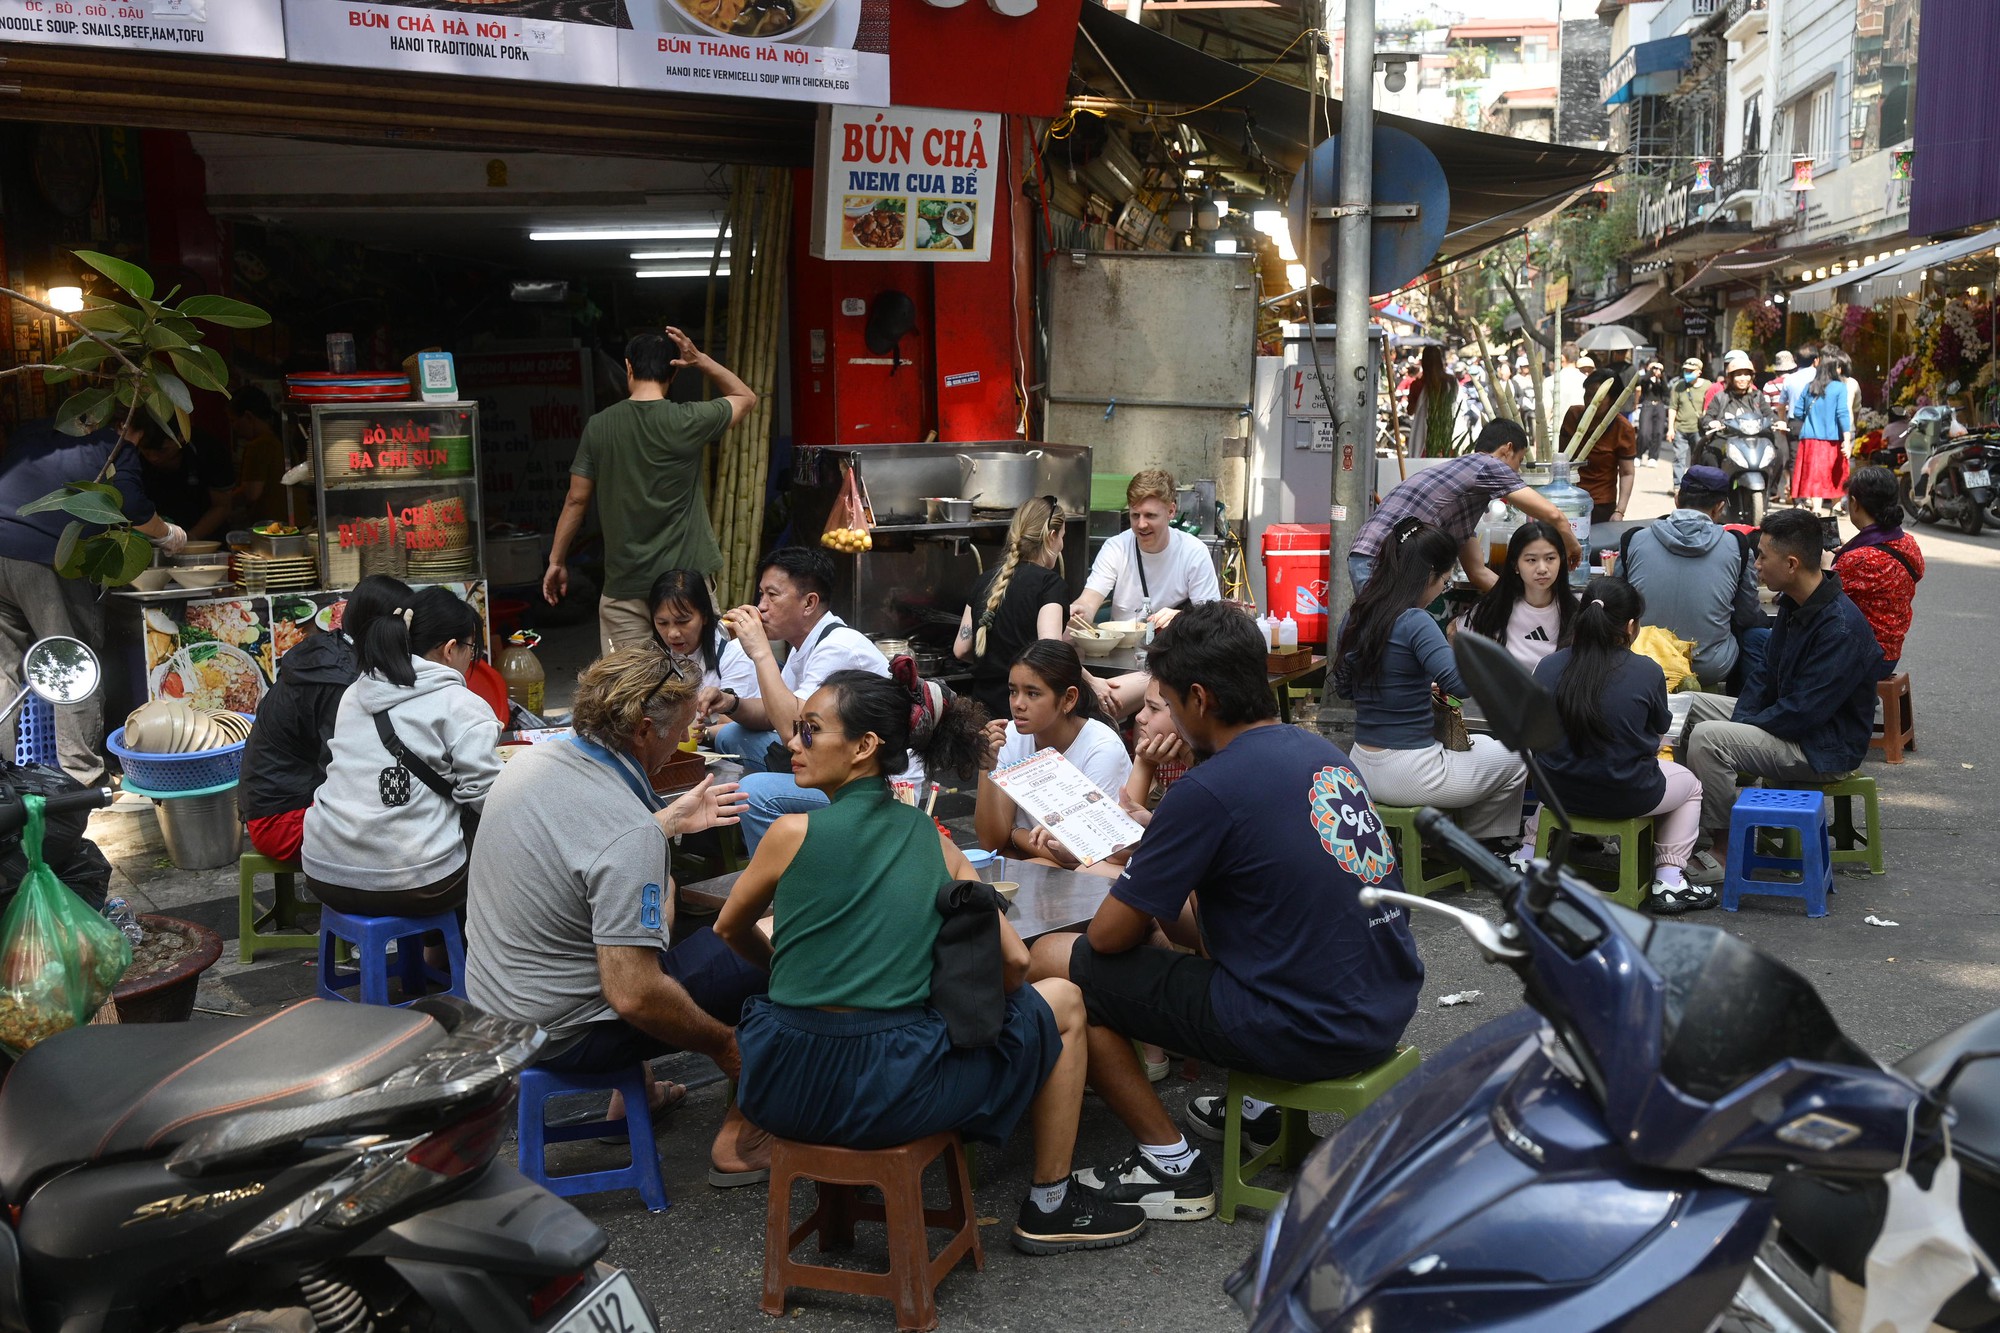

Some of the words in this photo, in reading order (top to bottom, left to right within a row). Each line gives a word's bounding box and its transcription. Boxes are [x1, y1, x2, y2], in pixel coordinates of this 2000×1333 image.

[0, 16, 43, 32] NOODLE
[47, 20, 79, 35] SOUP:
[83, 22, 204, 43] SNAILS,BEEF,HAM,TOFU
[348, 10, 389, 29] BÚN
[397, 14, 436, 33] CHẢ
[443, 17, 470, 36] HÀ
[476, 22, 507, 41] NỘI
[390, 35, 424, 53] HANOI
[427, 39, 497, 59] TRADITIONAL
[500, 45, 530, 61] PORK
[657, 36, 691, 54] BÚN
[698, 41, 751, 59] THANG
[756, 45, 778, 62] HÀ
[784, 49, 809, 67] NỘI
[666, 65, 691, 77] HANOI
[693, 67, 711, 79] RICE
[712, 69, 758, 82] VERMICELLI
[760, 73, 780, 84] SOUP
[781, 74, 801, 86] WITH
[802, 76, 850, 90] CHICKEN,EGG
[842, 113, 914, 165] BÚN
[922, 118, 988, 169] CHẢ
[849, 170, 900, 192] NEM
[906, 173, 946, 194] CUA
[951, 168, 978, 195] BỂ
[362, 423, 386, 445] BÒ
[349, 450, 374, 469] BA
[412, 448, 448, 470] SỤN
[338, 516, 379, 548] BÚN
[1046, 1194, 1062, 1203] miu
[1047, 1188, 1062, 1197] miu
